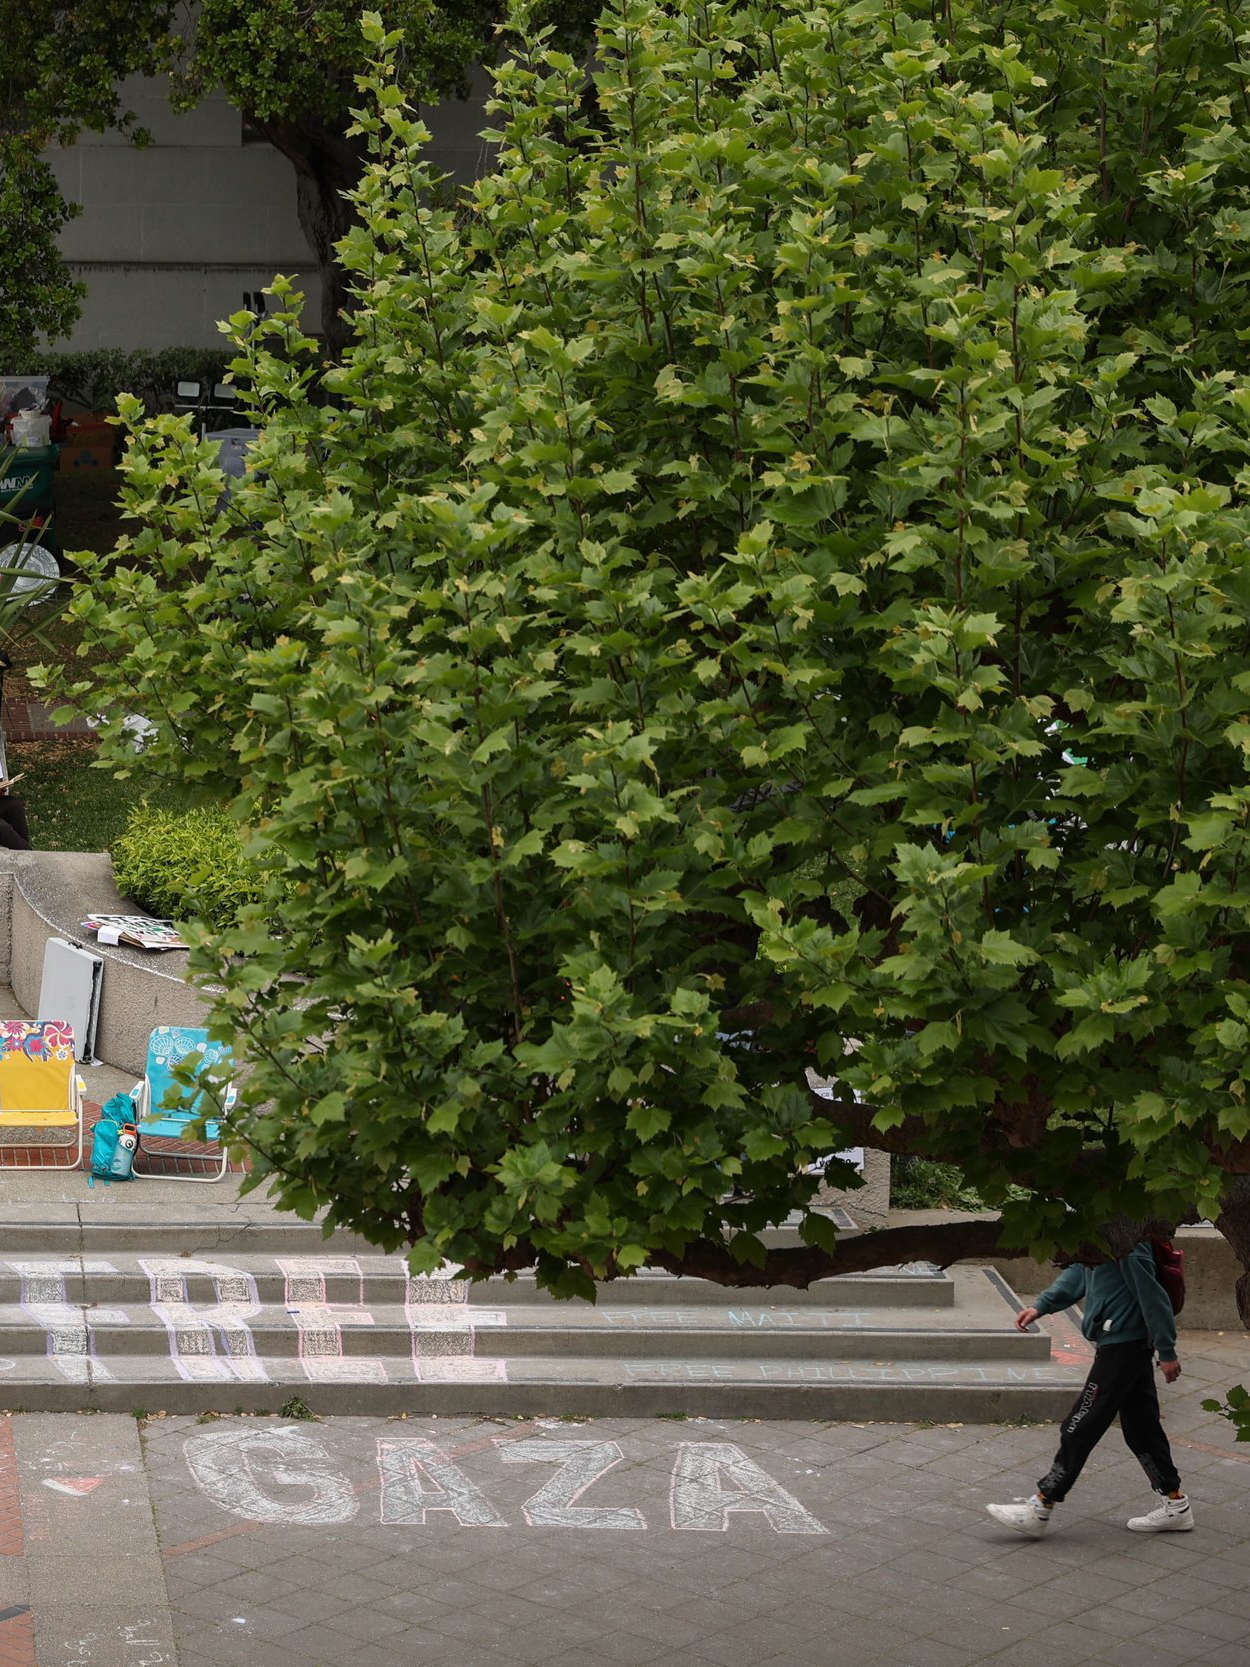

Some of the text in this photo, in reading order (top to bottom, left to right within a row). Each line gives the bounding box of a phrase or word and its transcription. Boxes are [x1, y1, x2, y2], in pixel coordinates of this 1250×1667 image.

[0, 475, 32, 489] WM
[4, 1256, 507, 1383] FREE
[602, 1311, 698, 1325] FREE
[623, 1363, 736, 1378] FREE
[183, 1425, 833, 1535] GAZA
